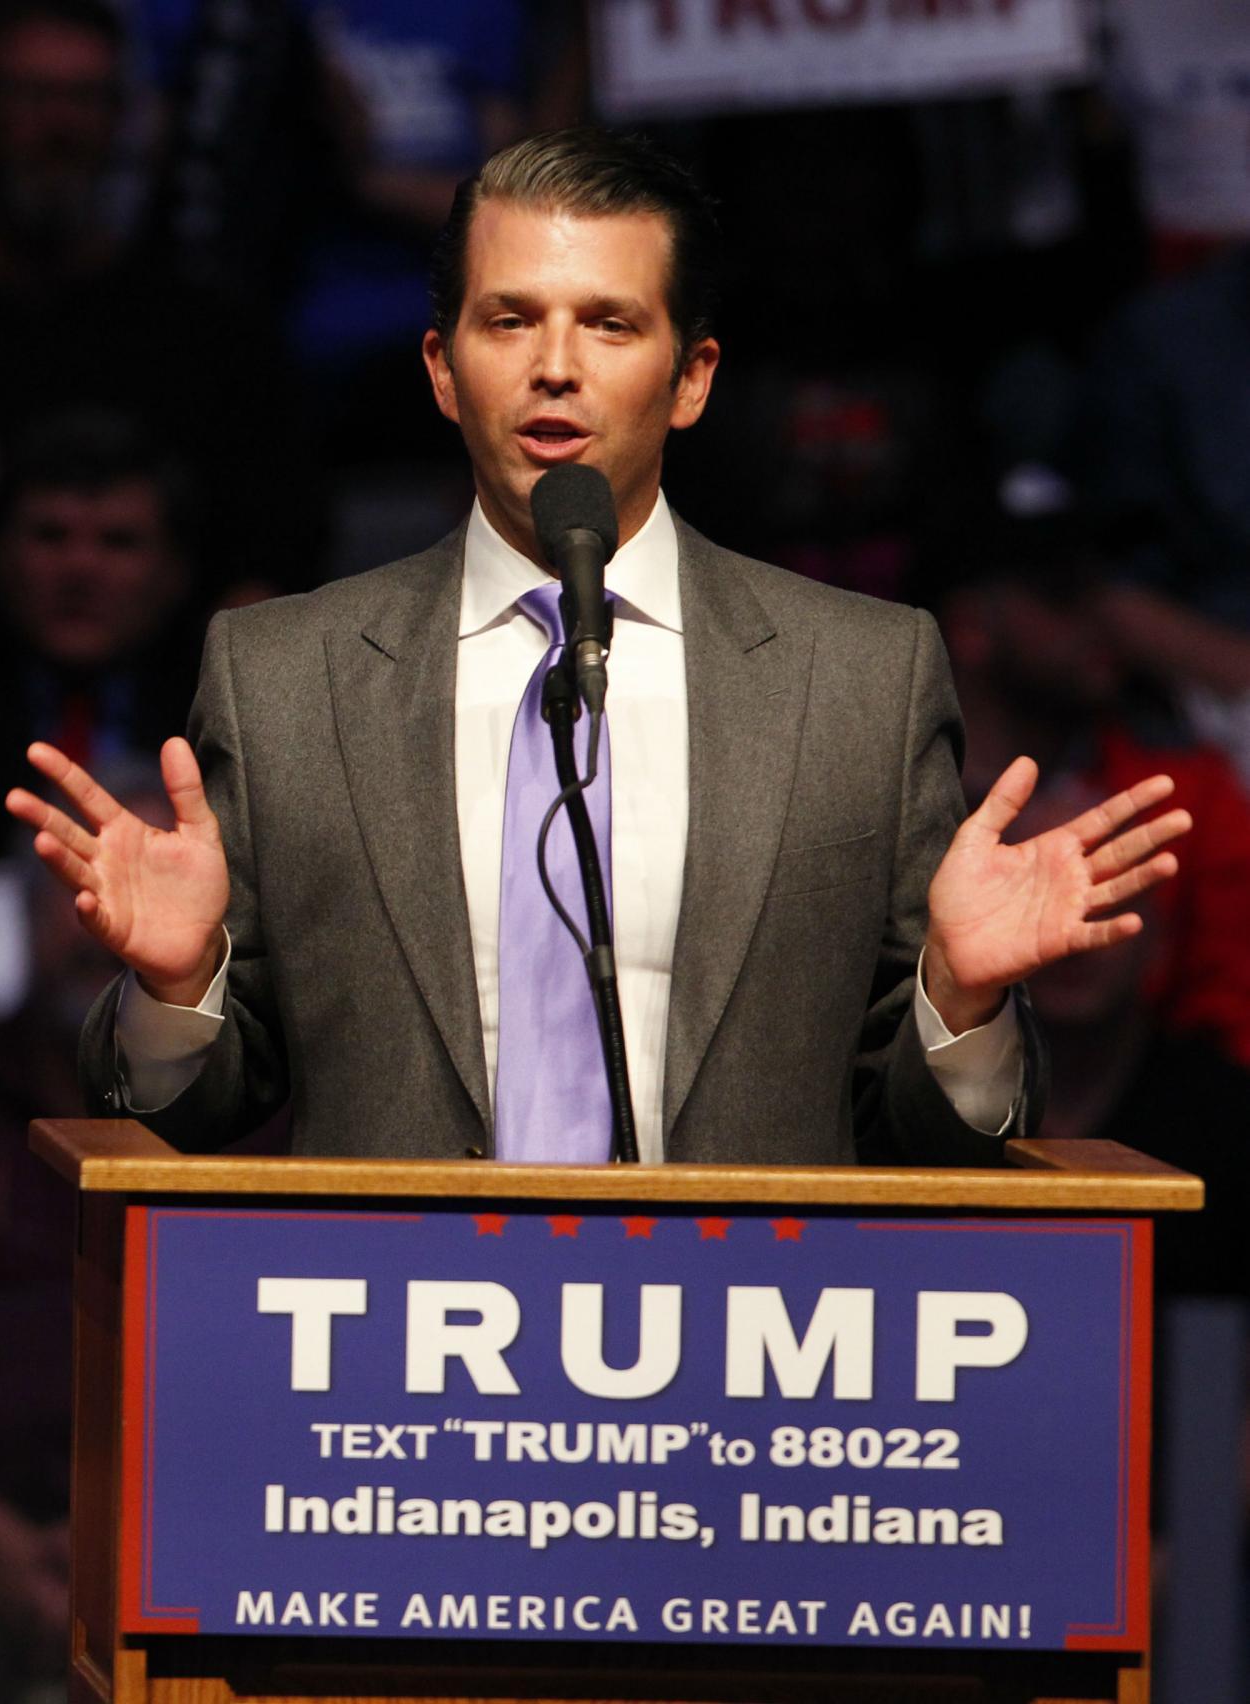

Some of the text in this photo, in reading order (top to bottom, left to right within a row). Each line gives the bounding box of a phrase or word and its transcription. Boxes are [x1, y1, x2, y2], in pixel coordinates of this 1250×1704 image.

[256, 1277, 1029, 1402] TRUMP
[310, 1423, 438, 1460] TEXT
[709, 1432, 756, 1466] to
[769, 1426, 960, 1470] 88022
[264, 1484, 1003, 1549] Indianapolis, Indiana
[235, 1590, 1031, 1639] MAKE AMERICA GREAT AGAIN!
